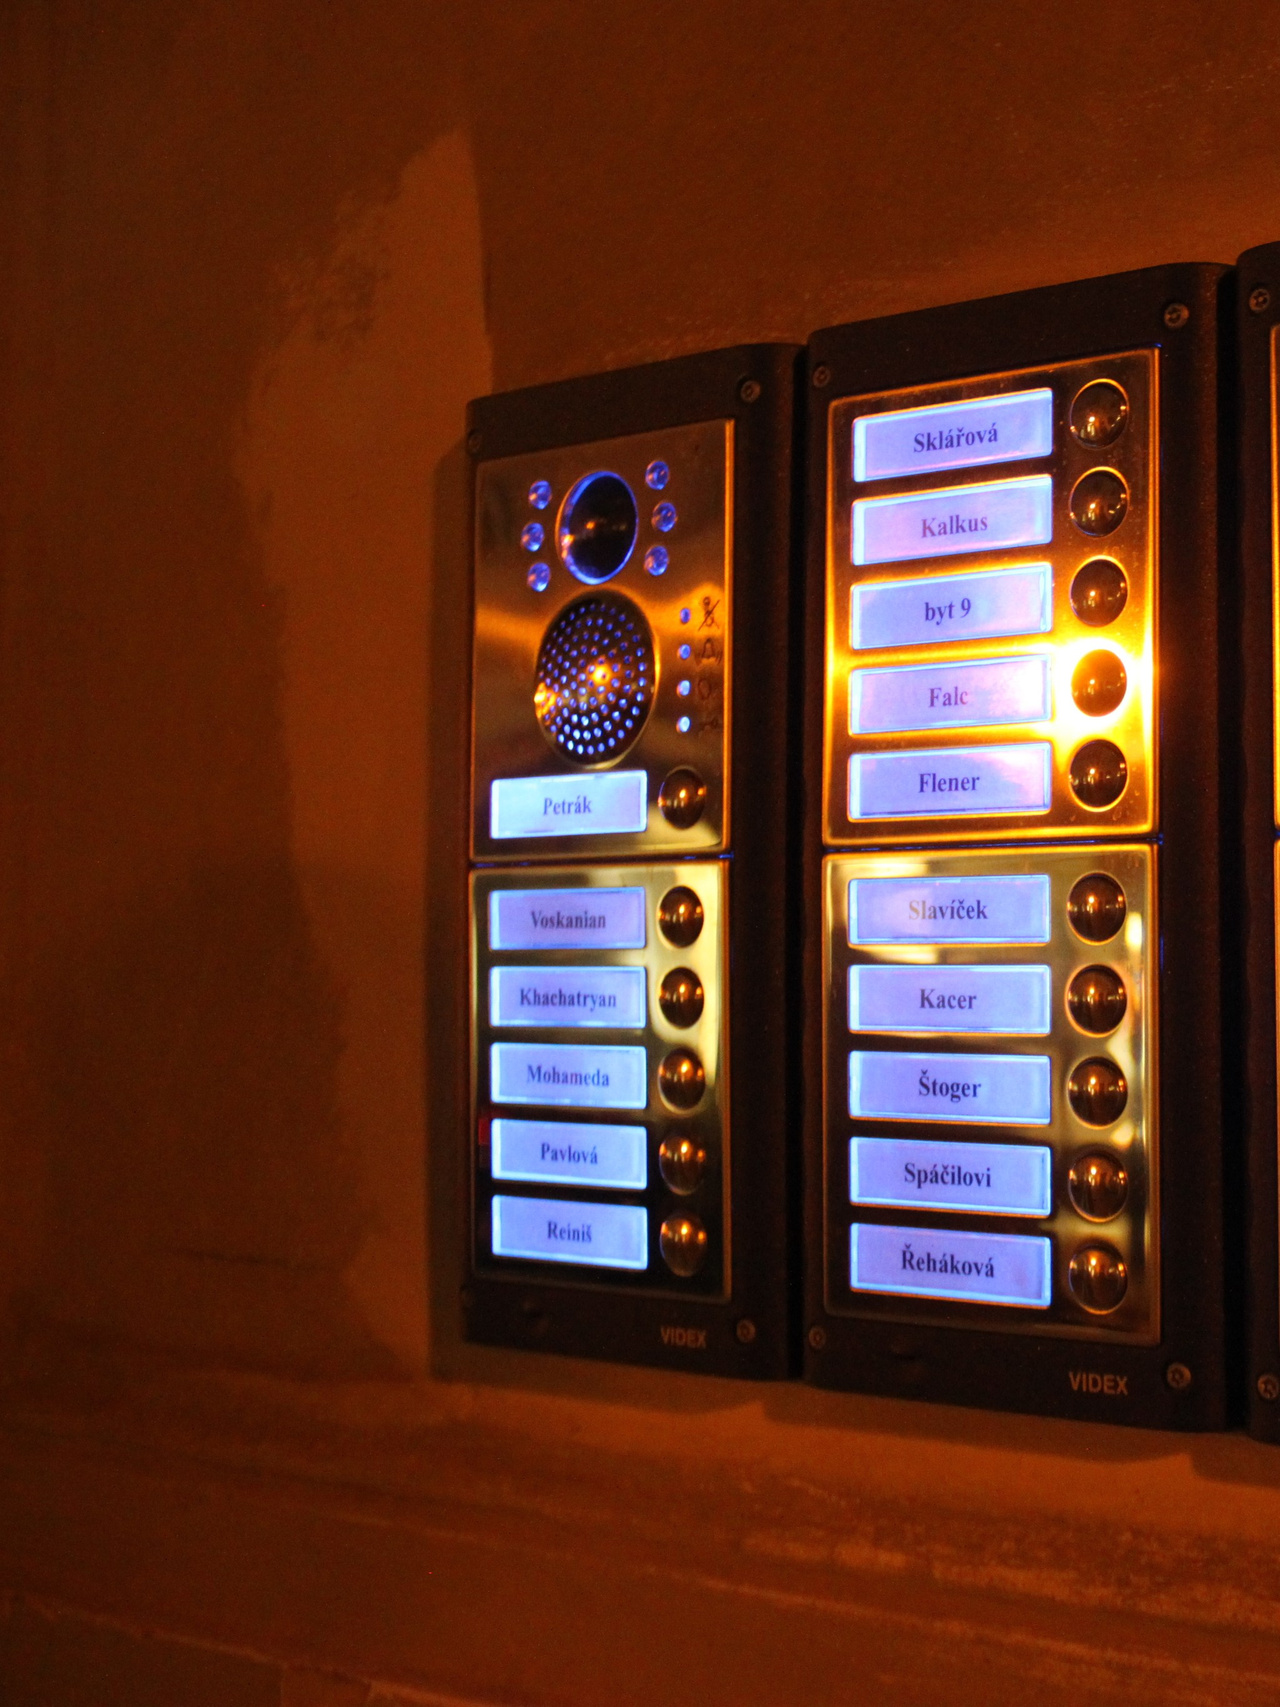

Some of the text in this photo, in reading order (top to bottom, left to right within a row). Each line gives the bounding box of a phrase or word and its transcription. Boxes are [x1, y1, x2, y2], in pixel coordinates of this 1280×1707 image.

[913, 422, 998, 454] Sklářová
[921, 514, 988, 538] Kalkus
[924, 597, 972, 625] byt 9
[928, 686, 968, 708] Falc
[918, 772, 981, 794] Flener
[543, 795, 592, 816] Petrák
[530, 910, 607, 930] Voskanian
[909, 897, 988, 920] Slavíček
[519, 987, 617, 1013] Khachatryan
[919, 988, 978, 1010] Kacer
[527, 1064, 610, 1088] Mohameda
[918, 1070, 982, 1102] Štoger
[540, 1142, 598, 1165] Pavlová
[904, 1162, 992, 1190] Spáčilovi
[547, 1220, 593, 1243] Reiniš
[901, 1243, 995, 1278] Řeháková
[661, 1326, 707, 1349] VIDEX
[1069, 1372, 1128, 1396] VIDEX
